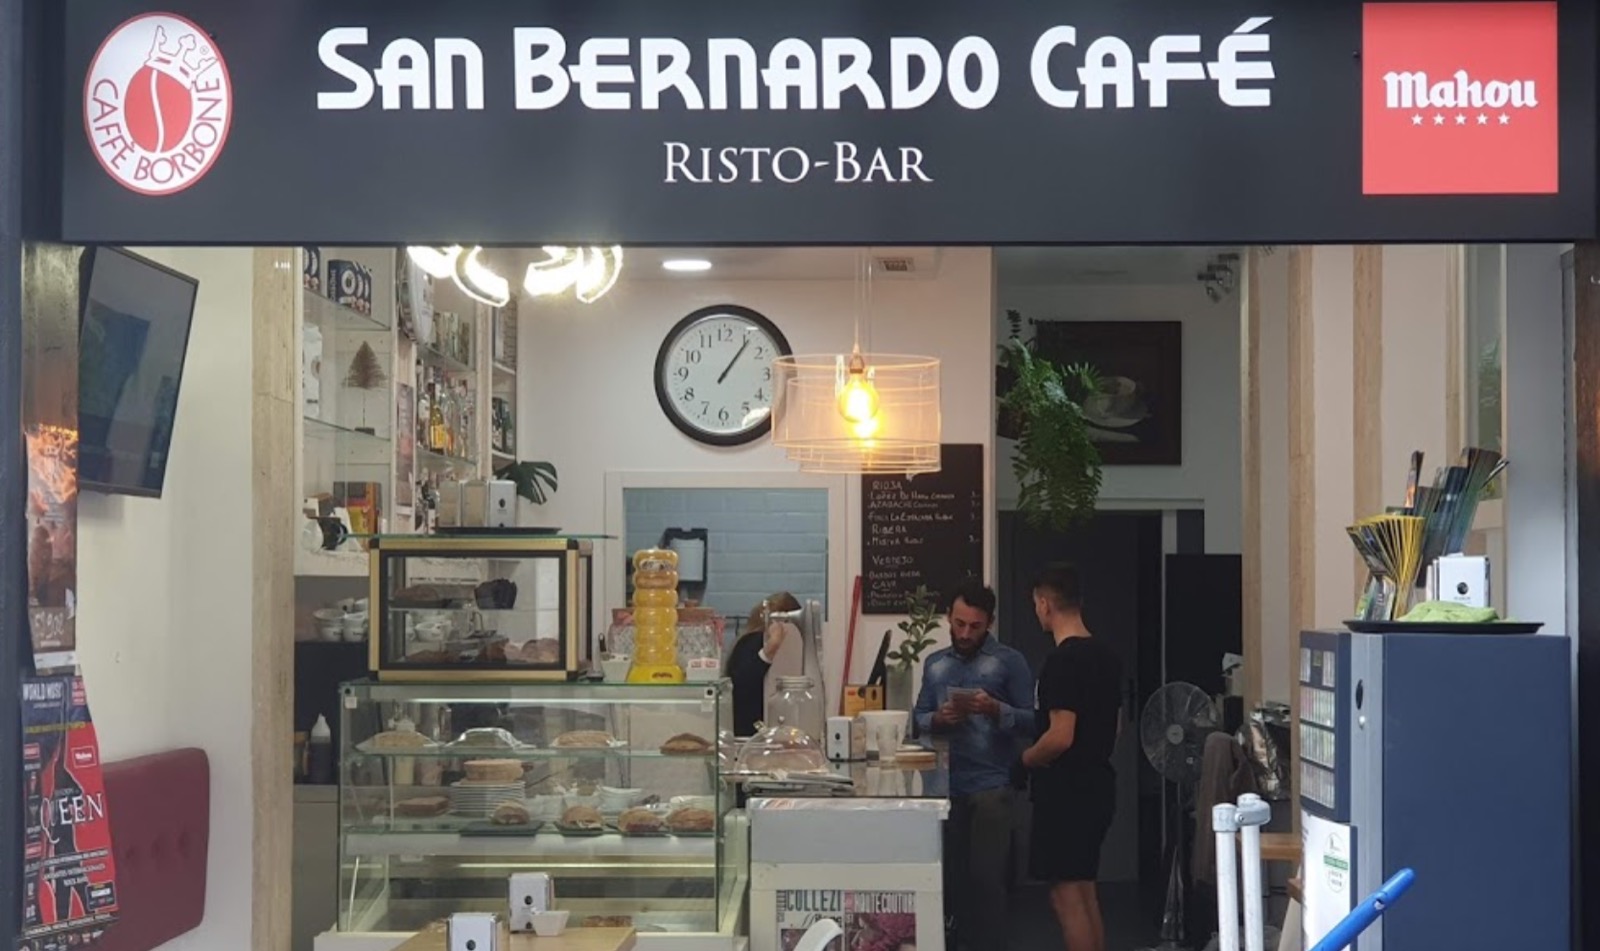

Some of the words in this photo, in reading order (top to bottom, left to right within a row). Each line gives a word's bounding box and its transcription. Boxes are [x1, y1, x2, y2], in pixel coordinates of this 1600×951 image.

[317, 27, 484, 110] SAN
[514, 27, 999, 110] BERNARDO
[1030, 17, 1275, 108] CAFÉ
[1382, 69, 1538, 108] Mahou
[93, 79, 135, 170] CAFFÈ
[134, 78, 222, 184] BORBONE
[664, 142, 933, 183] RISTO-BAR
[700, 334, 712, 348] 11
[717, 328, 733, 342] 12
[685, 350, 702, 364] 10
[754, 347, 764, 359] 2
[678, 367, 689, 381] 9
[763, 367, 771, 381] 3
[684, 387, 695, 401] 8
[754, 388, 763, 401] 4
[701, 401, 710, 415] 7
[718, 406, 729, 421] 6
[741, 402, 750, 416] 5
[40, 793, 103, 844] QUEEN
